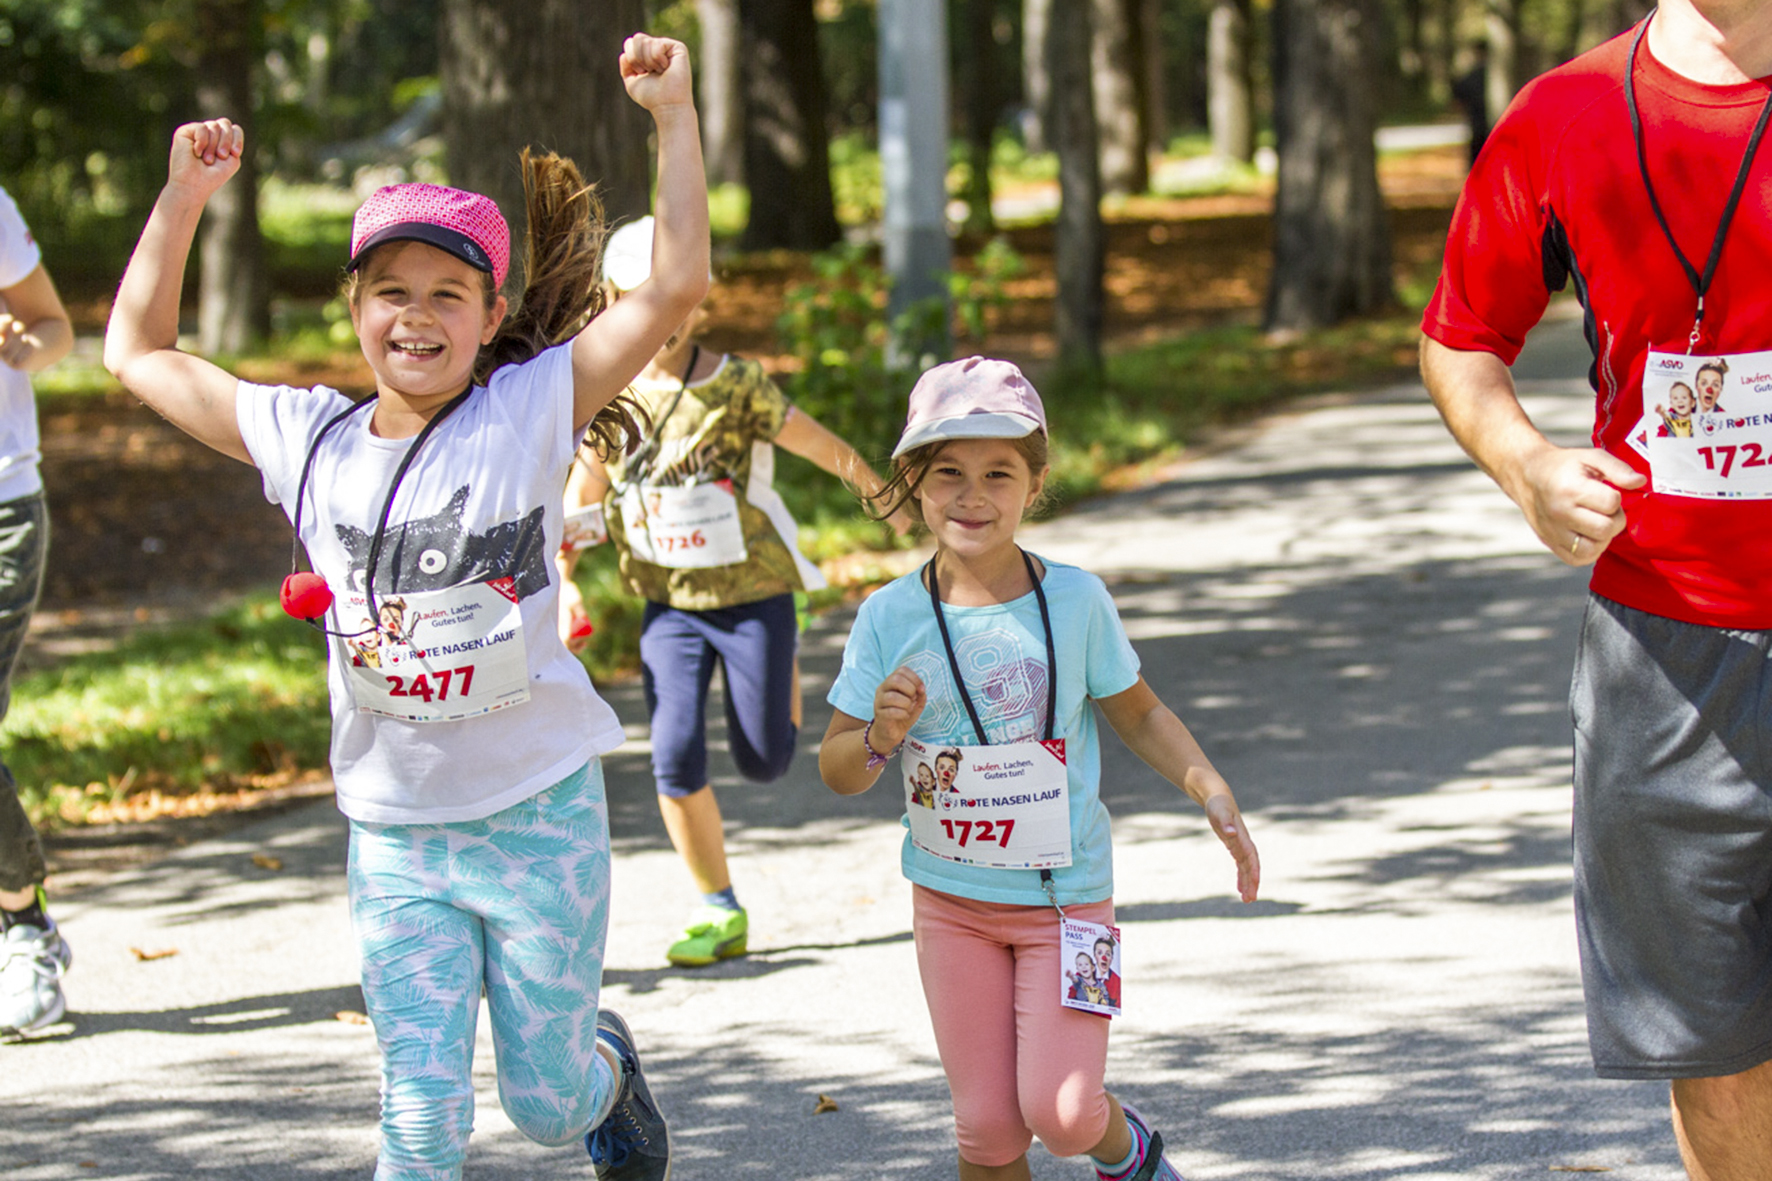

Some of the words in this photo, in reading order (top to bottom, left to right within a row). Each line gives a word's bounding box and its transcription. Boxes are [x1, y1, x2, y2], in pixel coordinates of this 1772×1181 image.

[1726, 415, 1761, 429] ROTE
[1697, 443, 1772, 479] 172
[656, 529, 706, 553] 1726
[431, 616, 456, 628] Gutes
[457, 613, 474, 624] tun!
[409, 647, 440, 660] ROTE
[442, 639, 484, 655] NASEN
[485, 630, 516, 646] LAUF
[385, 664, 475, 703] 2477
[984, 771, 1008, 780] Gutes
[1009, 769, 1025, 778] tun!
[960, 798, 990, 808] ROTE
[992, 795, 1031, 807] NASEN
[1033, 788, 1062, 802] LAUF
[940, 819, 1015, 849] 1727
[1065, 924, 1097, 936] STEMPEL
[1065, 931, 1084, 941] PASS
